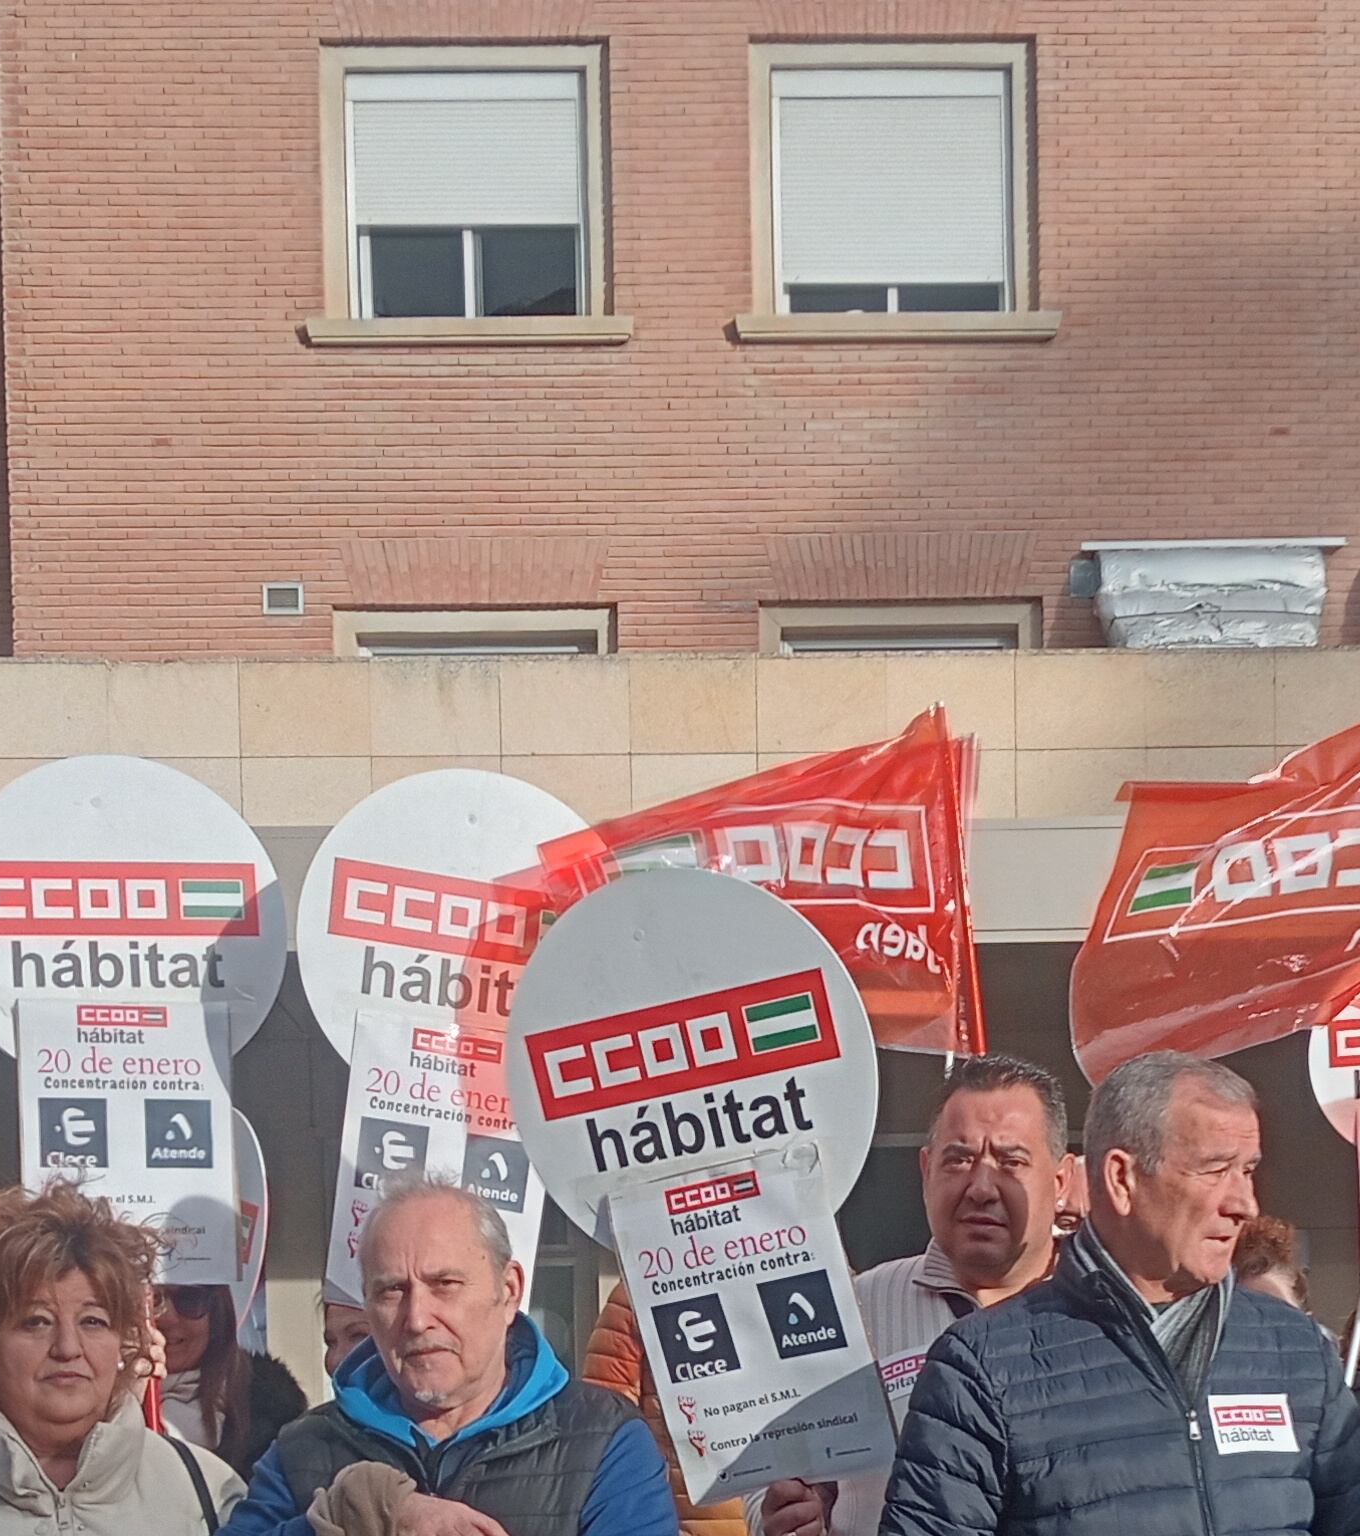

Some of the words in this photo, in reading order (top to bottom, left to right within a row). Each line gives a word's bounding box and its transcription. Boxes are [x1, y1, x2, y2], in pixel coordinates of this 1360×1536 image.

[344, 877, 527, 948] CCOO
[11, 940, 225, 989] hábitat
[361, 945, 515, 1017] hábit
[81, 1008, 139, 1023] CCOO
[77, 1027, 145, 1044] hábitat
[37, 1048, 71, 1074] 20
[81, 1046, 113, 1074] de
[122, 1055, 201, 1076] enero
[410, 1052, 477, 1078] hábitat
[543, 1011, 738, 1099] CCOO
[43, 1076, 147, 1090] Concentración
[153, 1079, 204, 1091] contra:
[366, 1068, 400, 1095] 20
[409, 1072, 441, 1102] de
[451, 1089, 512, 1114] ener
[370, 1096, 472, 1124] Concentración
[478, 1116, 517, 1130] contr
[585, 1076, 814, 1173] hábitat
[46, 1152, 98, 1168] Clece
[151, 1147, 206, 1160] Atende
[116, 1195, 125, 1203] el
[669, 1181, 731, 1211] CCOO
[670, 1204, 742, 1236] hábitat
[638, 1247, 673, 1280] 20
[683, 1236, 715, 1270] de
[724, 1224, 807, 1261] enero
[651, 1260, 755, 1296] Concentración
[760, 1251, 816, 1272] contra:
[675, 1358, 728, 1381] Clece
[781, 1326, 837, 1349] Atende
[881, 1358, 916, 1380] COO
[703, 1407, 720, 1418] No
[722, 1400, 757, 1416] pagan
[758, 1394, 769, 1406] el
[710, 1437, 748, 1451] Contra
[750, 1433, 760, 1443] la
[762, 1420, 815, 1441] represión
[817, 1413, 859, 1429] sindical
[1218, 1427, 1275, 1444] hábitat
